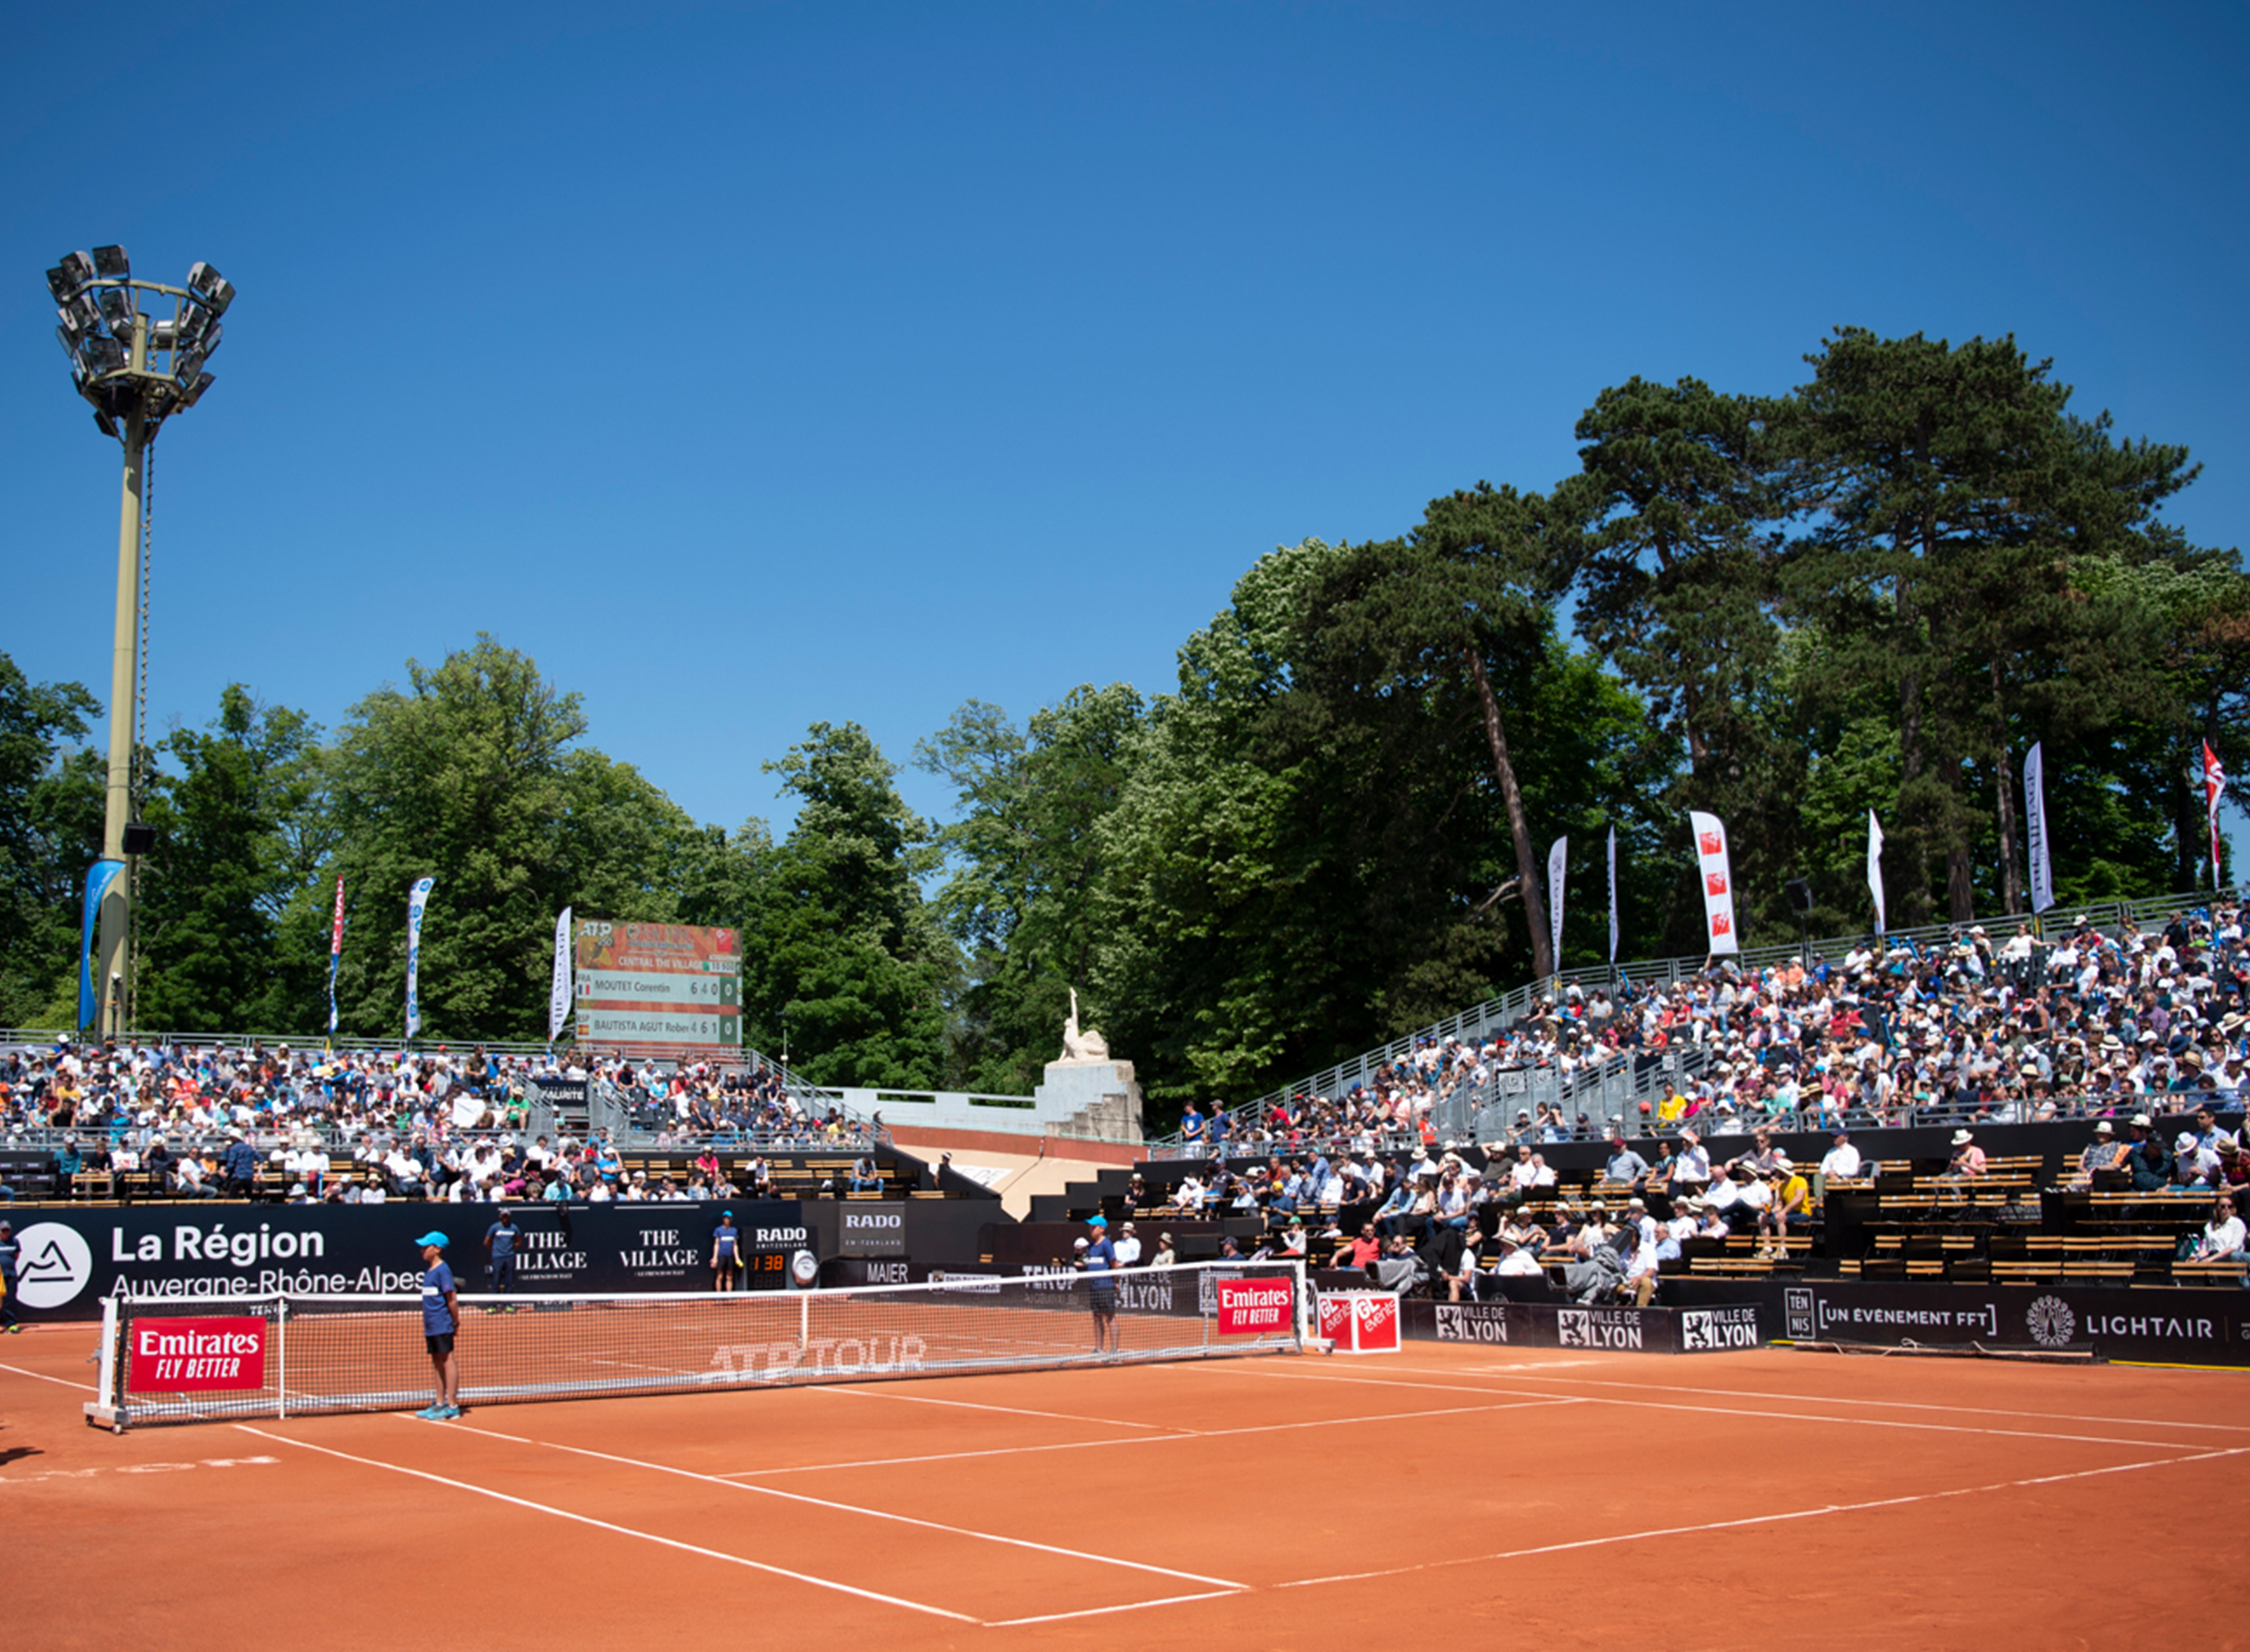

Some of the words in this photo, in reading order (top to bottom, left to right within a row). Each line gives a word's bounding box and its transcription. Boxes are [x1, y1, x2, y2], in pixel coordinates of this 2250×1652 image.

[580, 922, 612, 937] ATP
[618, 956, 653, 967] CENTRAL
[656, 959, 670, 968] THE
[672, 960, 703, 970] VILLAGE
[577, 974, 591, 982] FRA
[595, 980, 632, 992] MOUTET
[634, 982, 670, 993] Corentin
[691, 982, 698, 995] 6
[701, 983, 708, 994] 4
[711, 983, 719, 996] 0
[724, 983, 733, 997] 0
[577, 1014, 590, 1022] ESP
[594, 1019, 637, 1031] BAUTISTA
[639, 1021, 663, 1032] AGUT
[690, 1022, 697, 1033] 4
[701, 1021, 708, 1034] 6
[712, 1022, 717, 1034] 1
[724, 1022, 733, 1036] 0
[846, 1215, 901, 1228] RADO
[524, 1231, 567, 1249] THE
[639, 1229, 680, 1246] THE
[756, 1227, 807, 1242] RADO
[112, 1227, 162, 1261] La
[175, 1223, 324, 1267] Région
[515, 1252, 587, 1270] ILLAGE
[619, 1249, 699, 1268] VILLAGE
[765, 1255, 783, 1270] 38
[111, 1265, 425, 1297] Auvergne-Rhône-Alpes
[867, 1263, 908, 1283] MAIER
[1130, 1285, 1172, 1310] LYON
[1222, 1287, 1289, 1308] Emirates
[1789, 1296, 1808, 1309] TEN
[1232, 1309, 1248, 1325] FLY
[1249, 1307, 1279, 1324] BETTER
[1320, 1296, 1339, 1319] GL
[1357, 1296, 1381, 1320] GL
[1364, 1299, 1396, 1332] events
[1462, 1306, 1488, 1319] VILLE
[1491, 1307, 1505, 1320] DE
[1712, 1310, 1739, 1323] VILLE
[1742, 1308, 1755, 1322] DE
[1325, 1302, 1352, 1332] events
[1589, 1311, 1621, 1324] VILLE
[1625, 1311, 1640, 1325] DE
[1792, 1318, 1809, 1331] NIS
[1464, 1320, 1508, 1342] LYON
[1714, 1324, 1757, 1347] LYON
[2087, 1315, 2213, 1338] LIGHTAIR
[140, 1329, 259, 1356] Emirates
[1591, 1324, 1642, 1349] LYON
[808, 1337, 927, 1375] TOUR
[155, 1359, 183, 1379] FLY
[185, 1357, 241, 1378] BETTER
